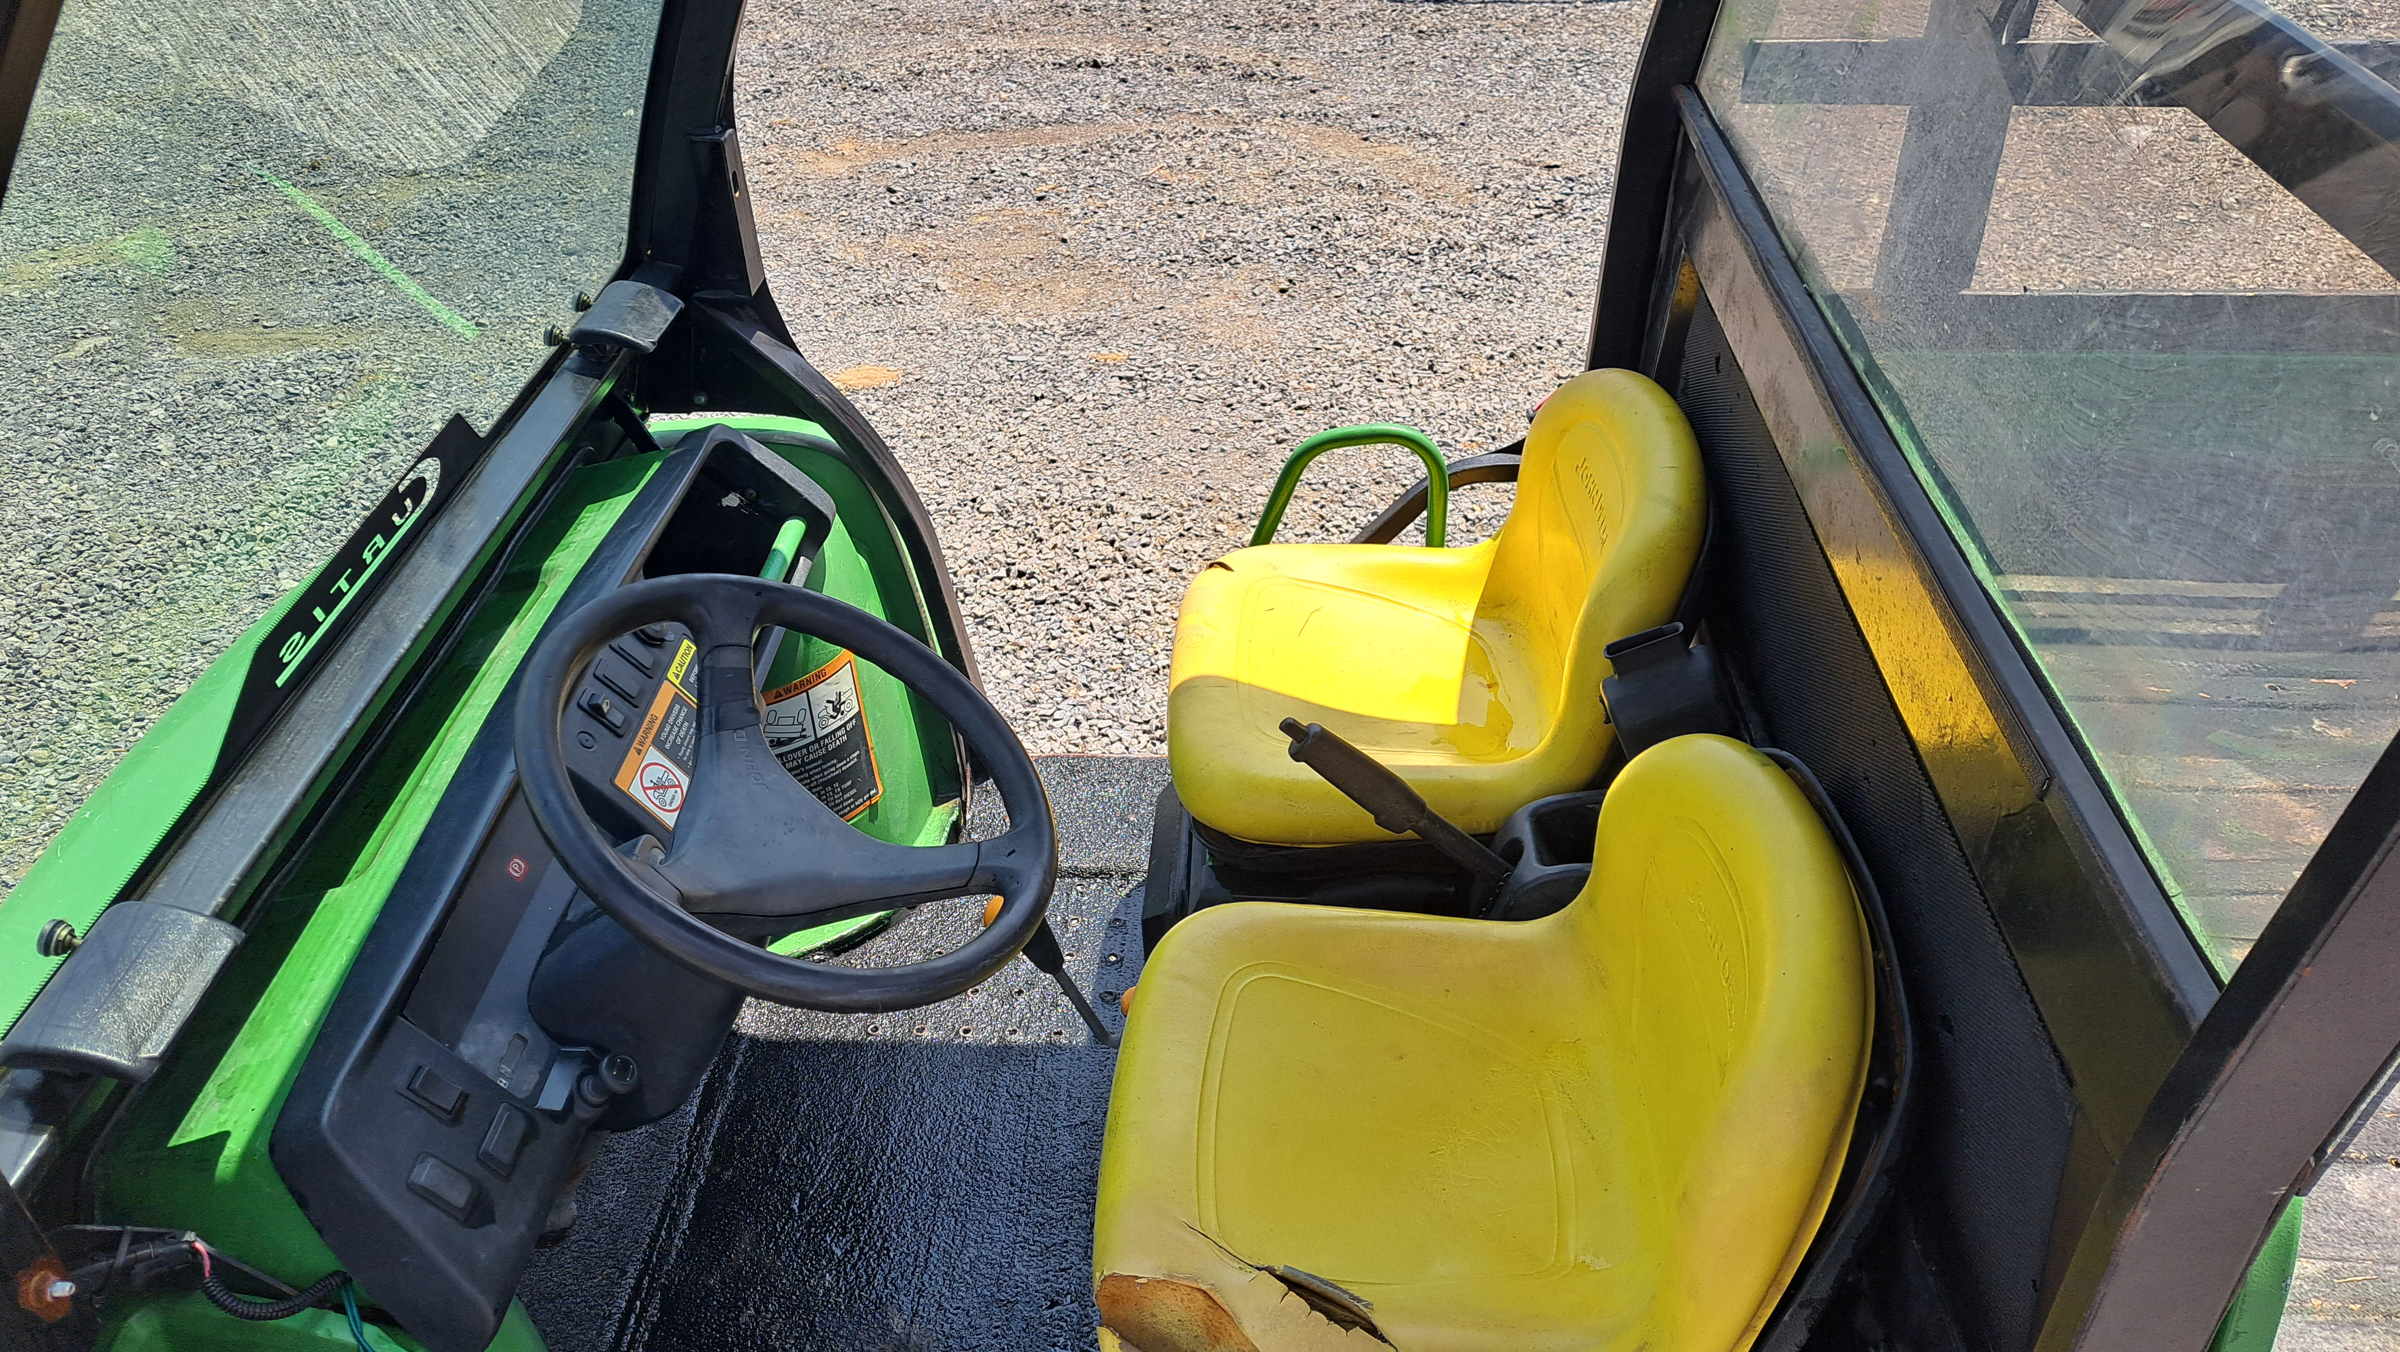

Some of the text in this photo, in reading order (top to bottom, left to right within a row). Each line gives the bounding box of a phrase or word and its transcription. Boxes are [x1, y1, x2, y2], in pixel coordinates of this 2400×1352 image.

[674, 644, 693, 673] CAUTION
[783, 668, 827, 695] WARNING
[639, 714, 657, 747] WARNING
[660, 704, 681, 741] YOUNG DRIVERS
[664, 706, 688, 750] INCREASE CHANCE
[676, 721, 689, 745] OF DEATH
[777, 718, 857, 764] LLOVER OR FALLING OFF
[785, 735, 848, 769] MAY CAUSE DEATH
